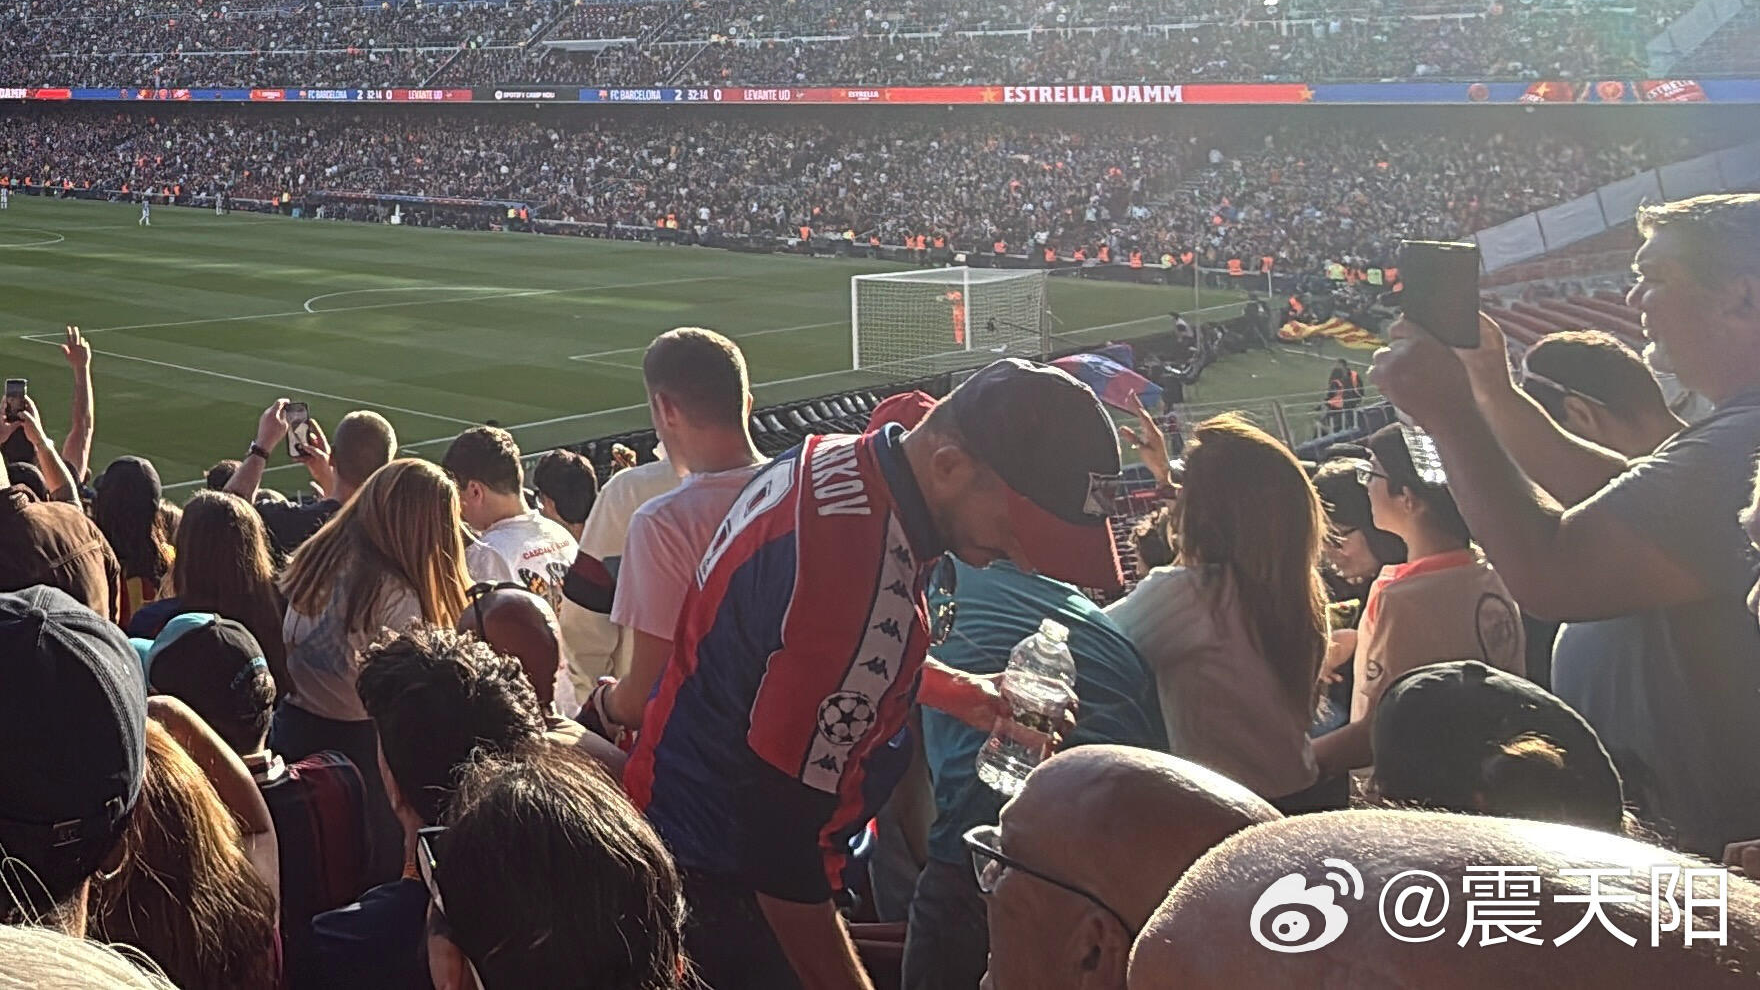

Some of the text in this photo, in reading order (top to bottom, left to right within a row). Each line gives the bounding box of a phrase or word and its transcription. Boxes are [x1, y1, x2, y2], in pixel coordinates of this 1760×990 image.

[317, 90, 347, 99] BARCELONA
[357, 90, 363, 99] 2
[386, 90, 392, 99] 0
[408, 90, 433, 100] LEVANTE
[610, 89, 620, 100] FC
[620, 89, 661, 100] BARCELONA
[674, 89, 683, 101] 2
[713, 89, 722, 101] 0
[743, 89, 777, 101] LEVANTE
[778, 90, 791, 101] UD
[1003, 85, 1184, 103] ESTRELLA DAMM
